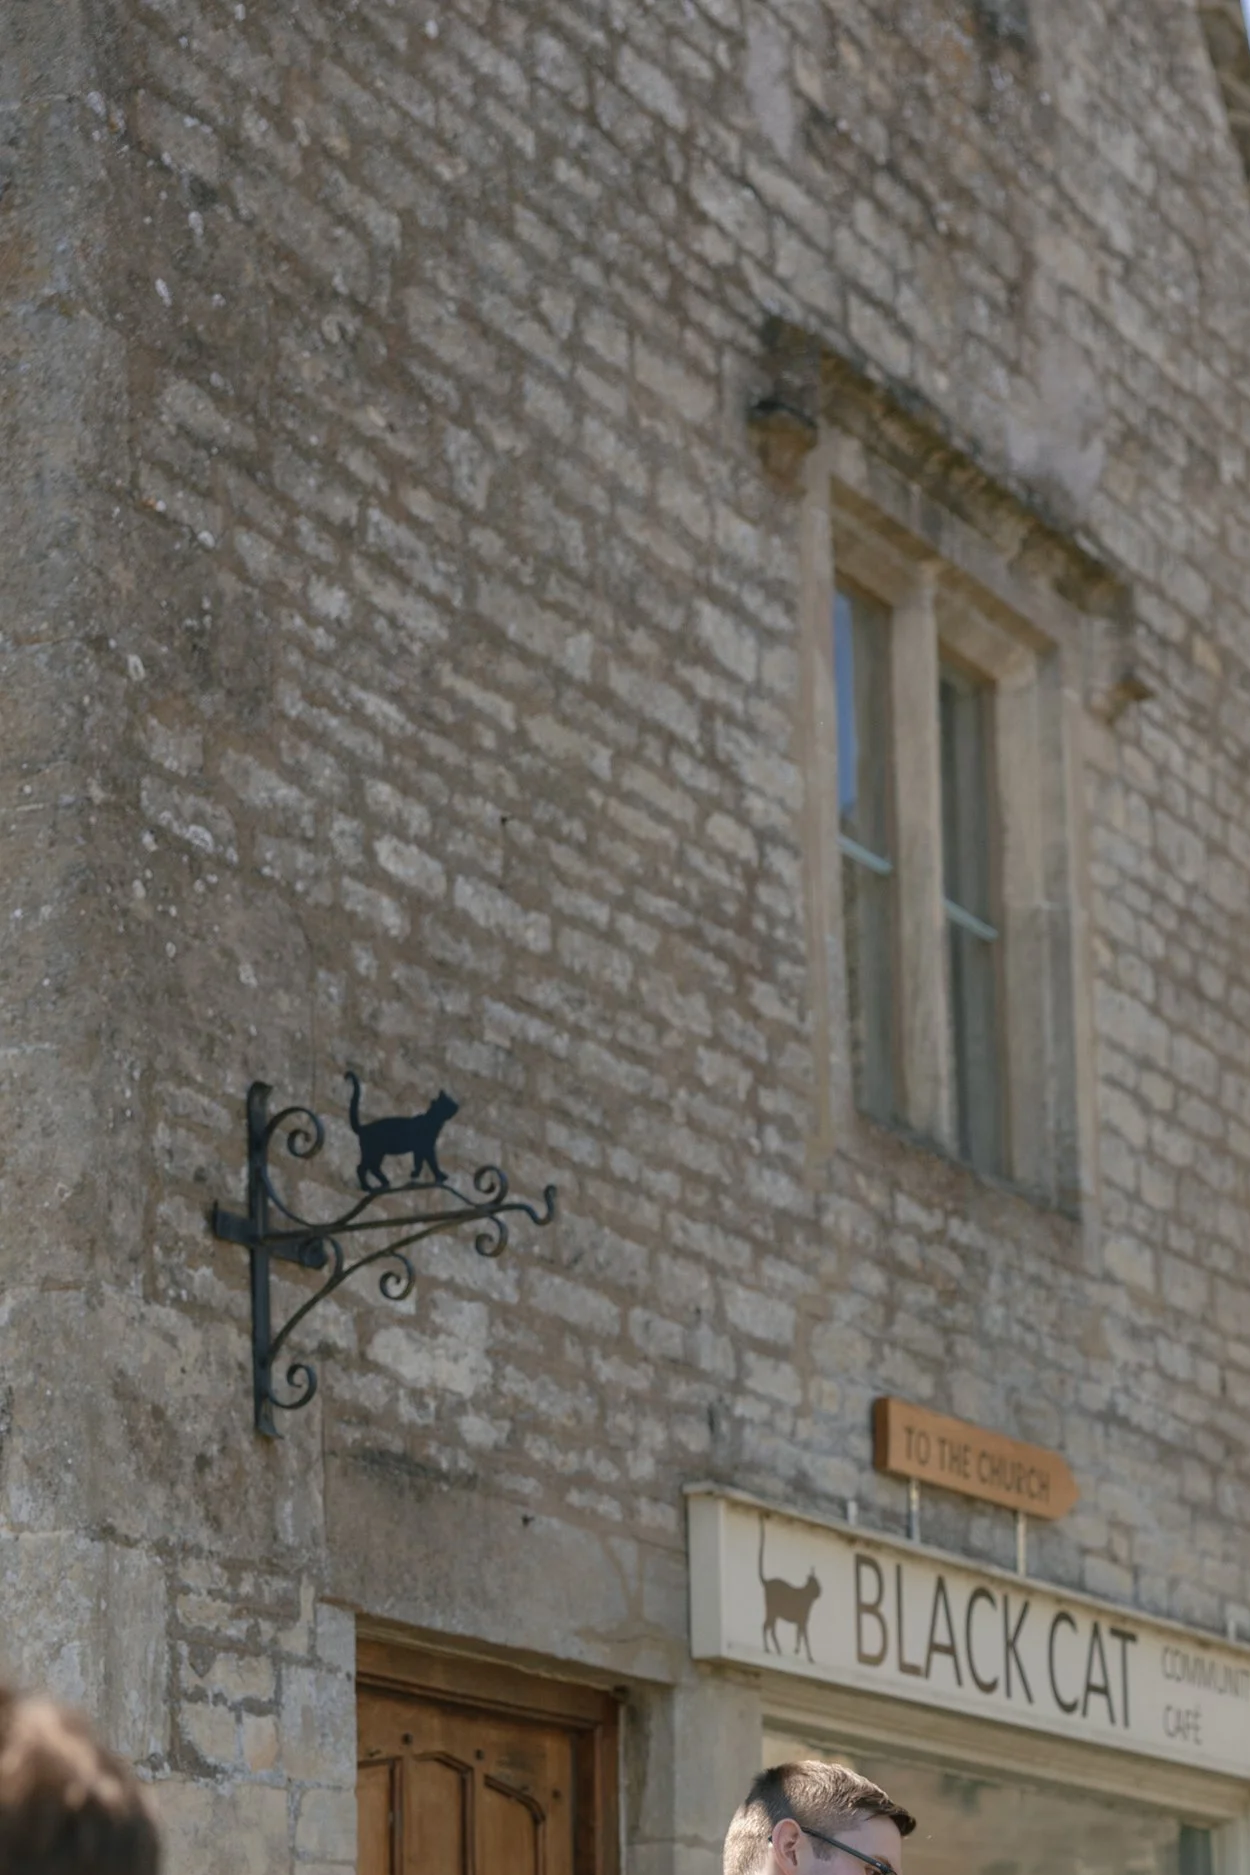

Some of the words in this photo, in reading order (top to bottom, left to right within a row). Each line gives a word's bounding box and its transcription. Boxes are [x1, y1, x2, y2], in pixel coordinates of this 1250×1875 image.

[904, 1425, 931, 1466] TO
[938, 1436, 971, 1480] THE
[979, 1450, 1050, 1505] CHURCH
[854, 1553, 1034, 1705] BLACK
[1048, 1609, 1138, 1729] CAT
